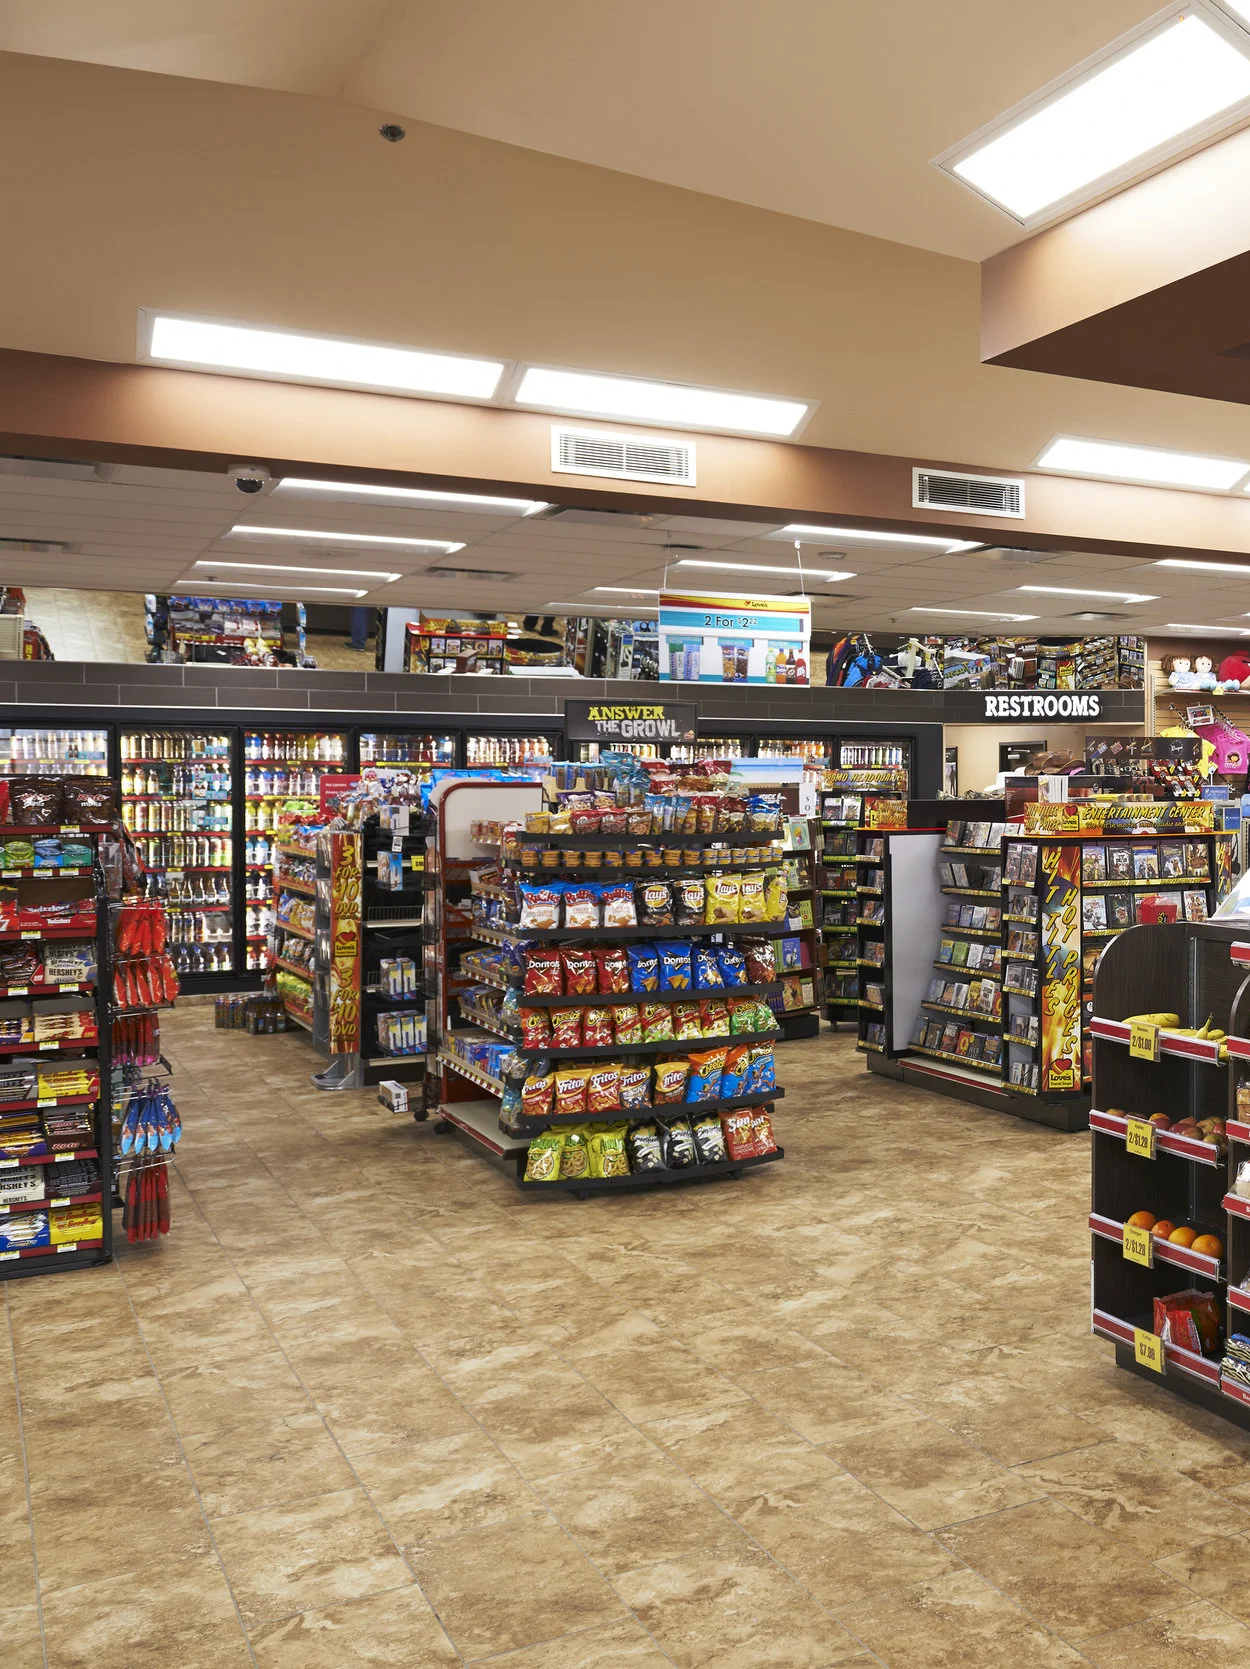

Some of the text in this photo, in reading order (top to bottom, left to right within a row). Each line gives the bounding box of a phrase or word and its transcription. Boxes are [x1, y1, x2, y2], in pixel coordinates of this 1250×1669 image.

[704, 615, 712, 626] 2
[716, 616, 734, 627] For
[984, 695, 1100, 716] RESTROOMS
[588, 705, 664, 720] ANSWER
[595, 720, 681, 738] THE GROWL
[1082, 805, 1206, 820] ENTERTAINMENT CENTER
[339, 845, 355, 866] 3
[335, 867, 359, 879] FOR
[335, 880, 360, 901] $10
[334, 902, 359, 914] DVD
[528, 959, 559, 969] Doritos
[663, 955, 692, 965] Doritos
[49, 968, 83, 976] HERSHEY'S
[338, 968, 354, 988] 3
[333, 989, 358, 1001] FOR
[334, 1002, 358, 1024] $10
[333, 1024, 357, 1036] DVD
[1050, 1073, 1072, 1081] Love's
